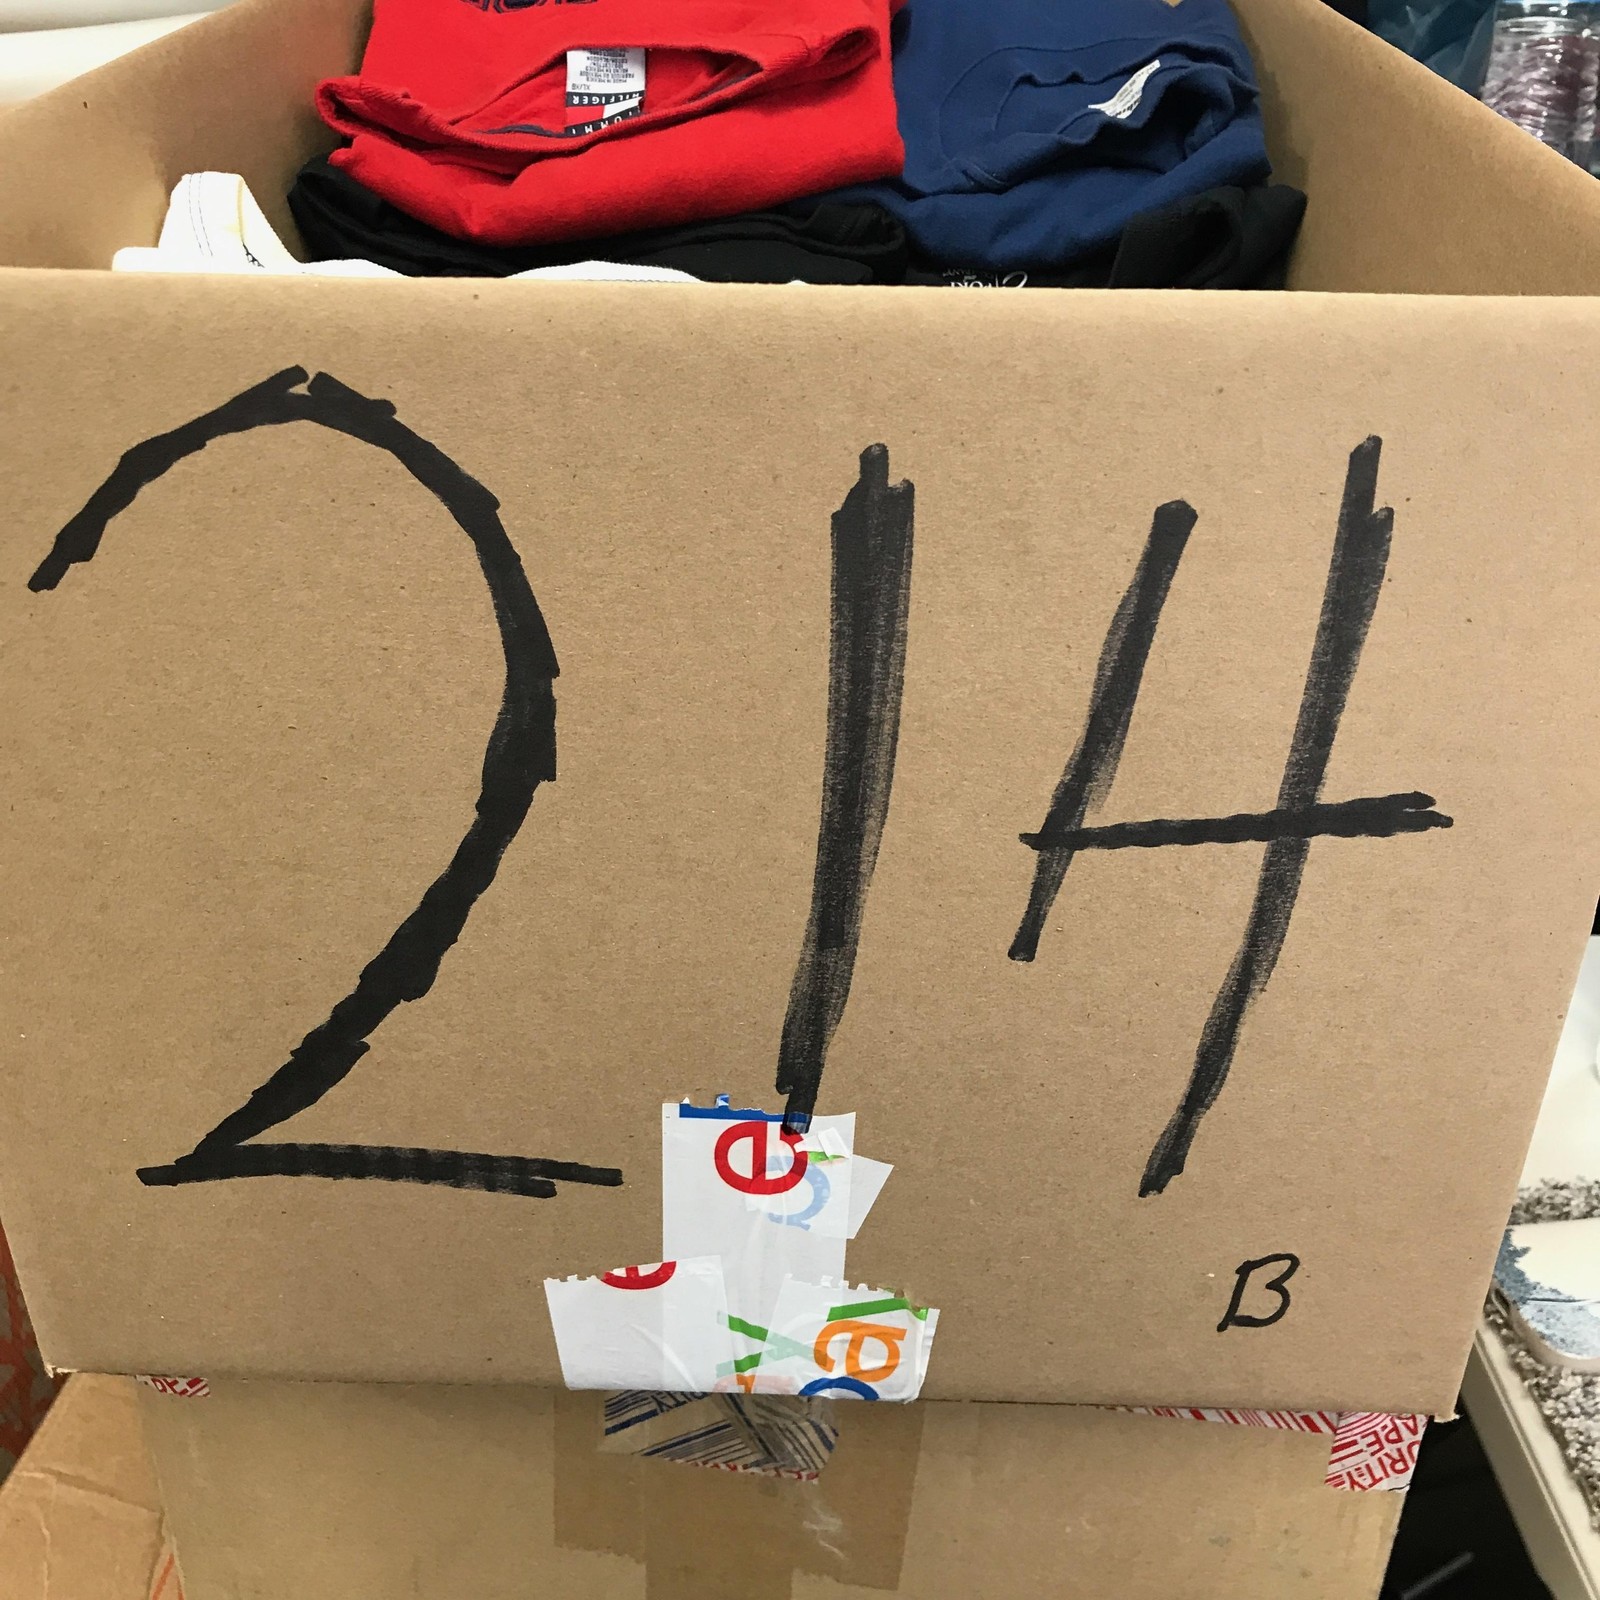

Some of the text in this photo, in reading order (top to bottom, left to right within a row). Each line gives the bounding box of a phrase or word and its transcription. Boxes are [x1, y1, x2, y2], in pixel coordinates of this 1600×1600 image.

[28, 365, 1453, 1198] 214
[1217, 1253, 1300, 1332] B
[1359, 1413, 1421, 1457] APE
